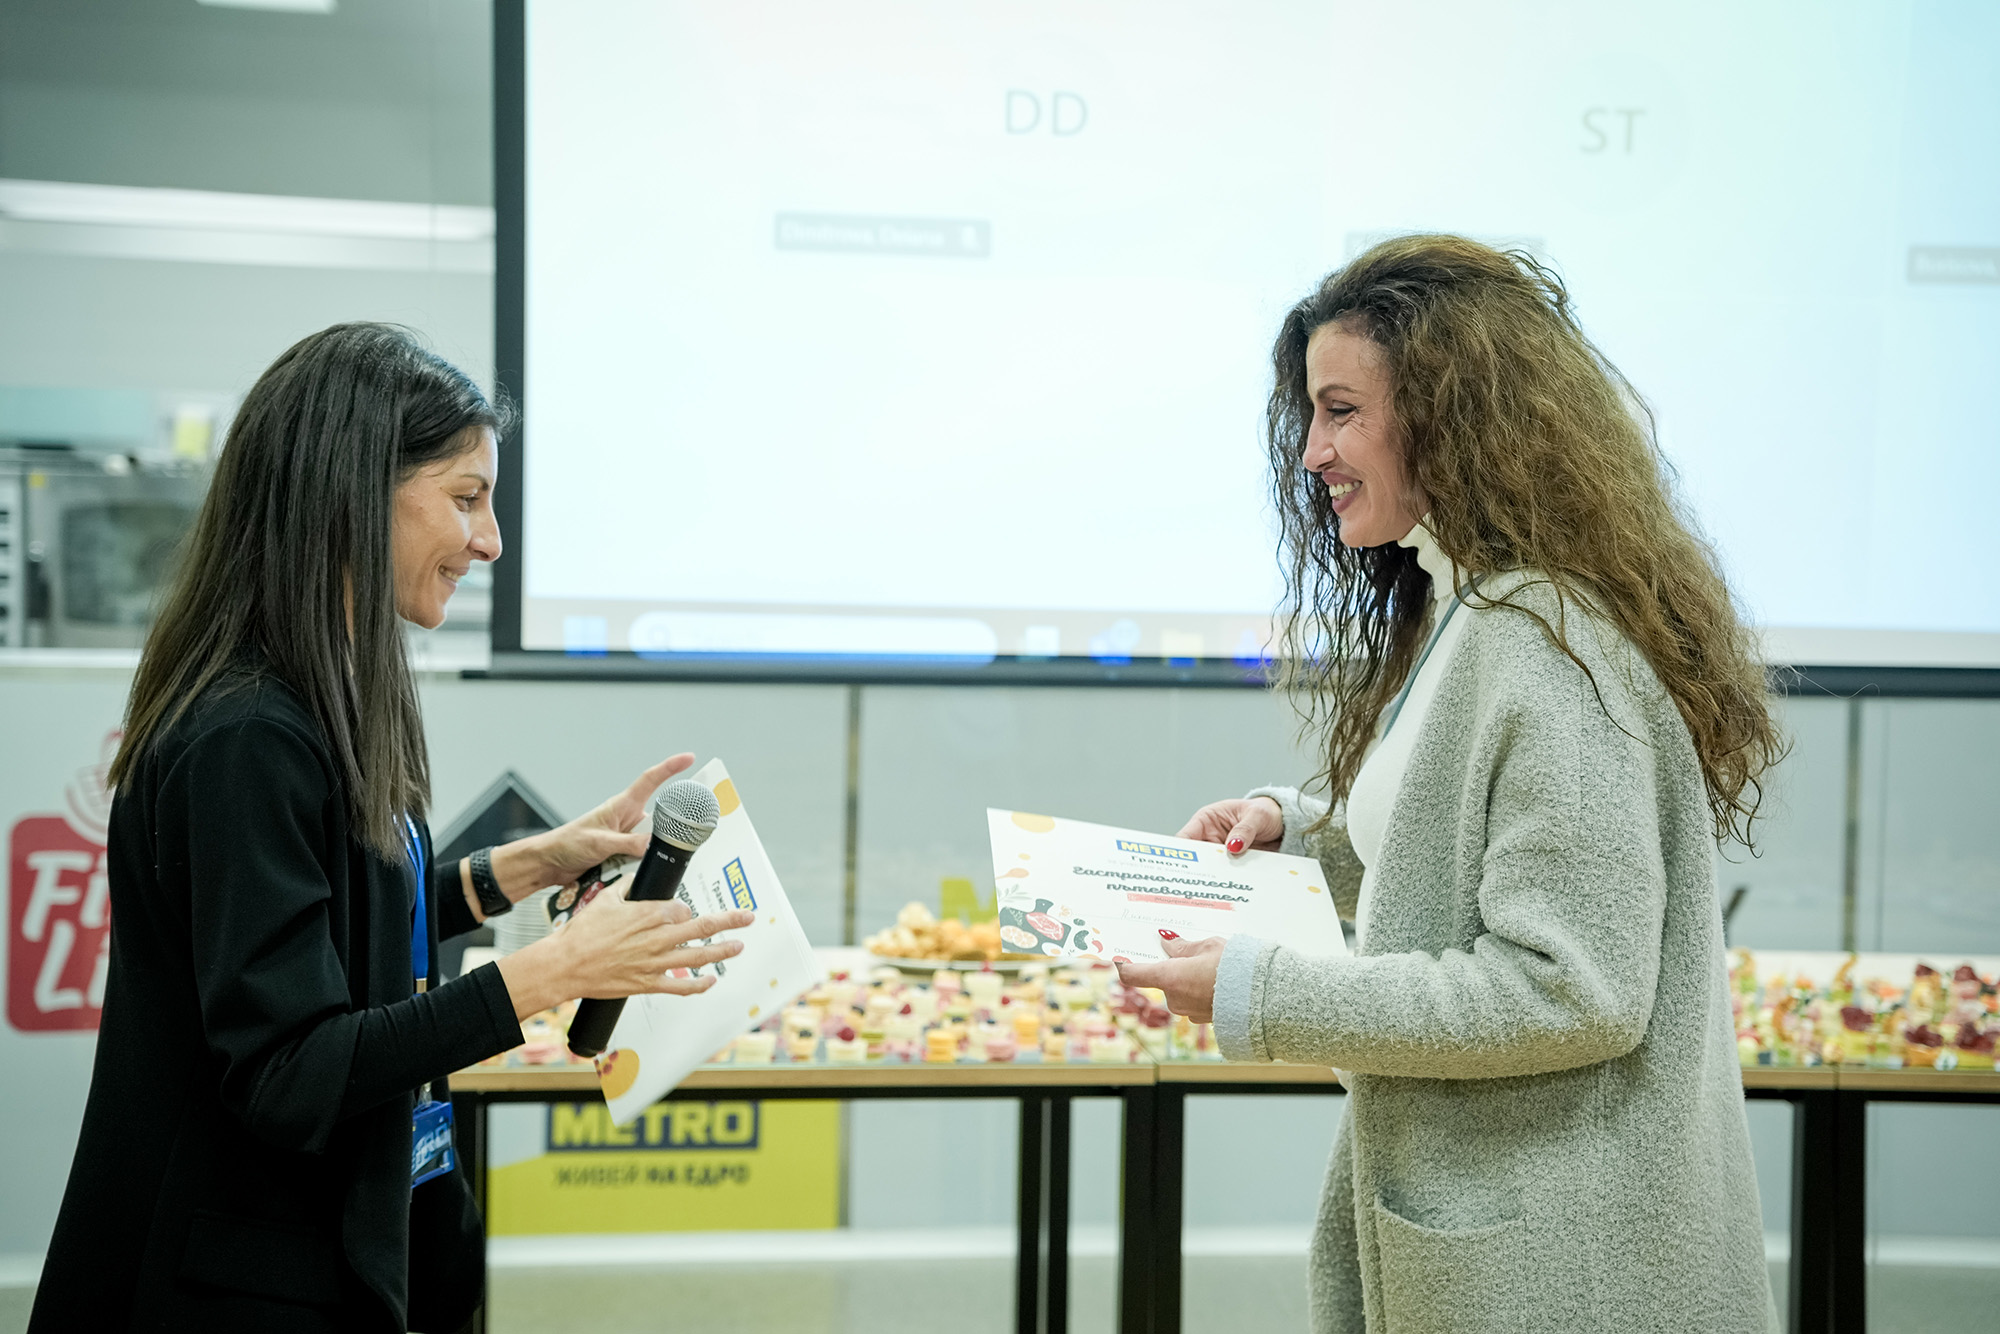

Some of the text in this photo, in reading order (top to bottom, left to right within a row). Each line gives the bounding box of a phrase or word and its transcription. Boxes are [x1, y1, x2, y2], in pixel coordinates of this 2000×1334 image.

[1005, 90, 1090, 136] DD
[1580, 106, 1647, 154] ST
[1120, 841, 1195, 861] METRO
[1131, 855, 1189, 869] Грамота
[1072, 866, 1254, 891] Гастрономически
[1106, 883, 1249, 903] пътеводител
